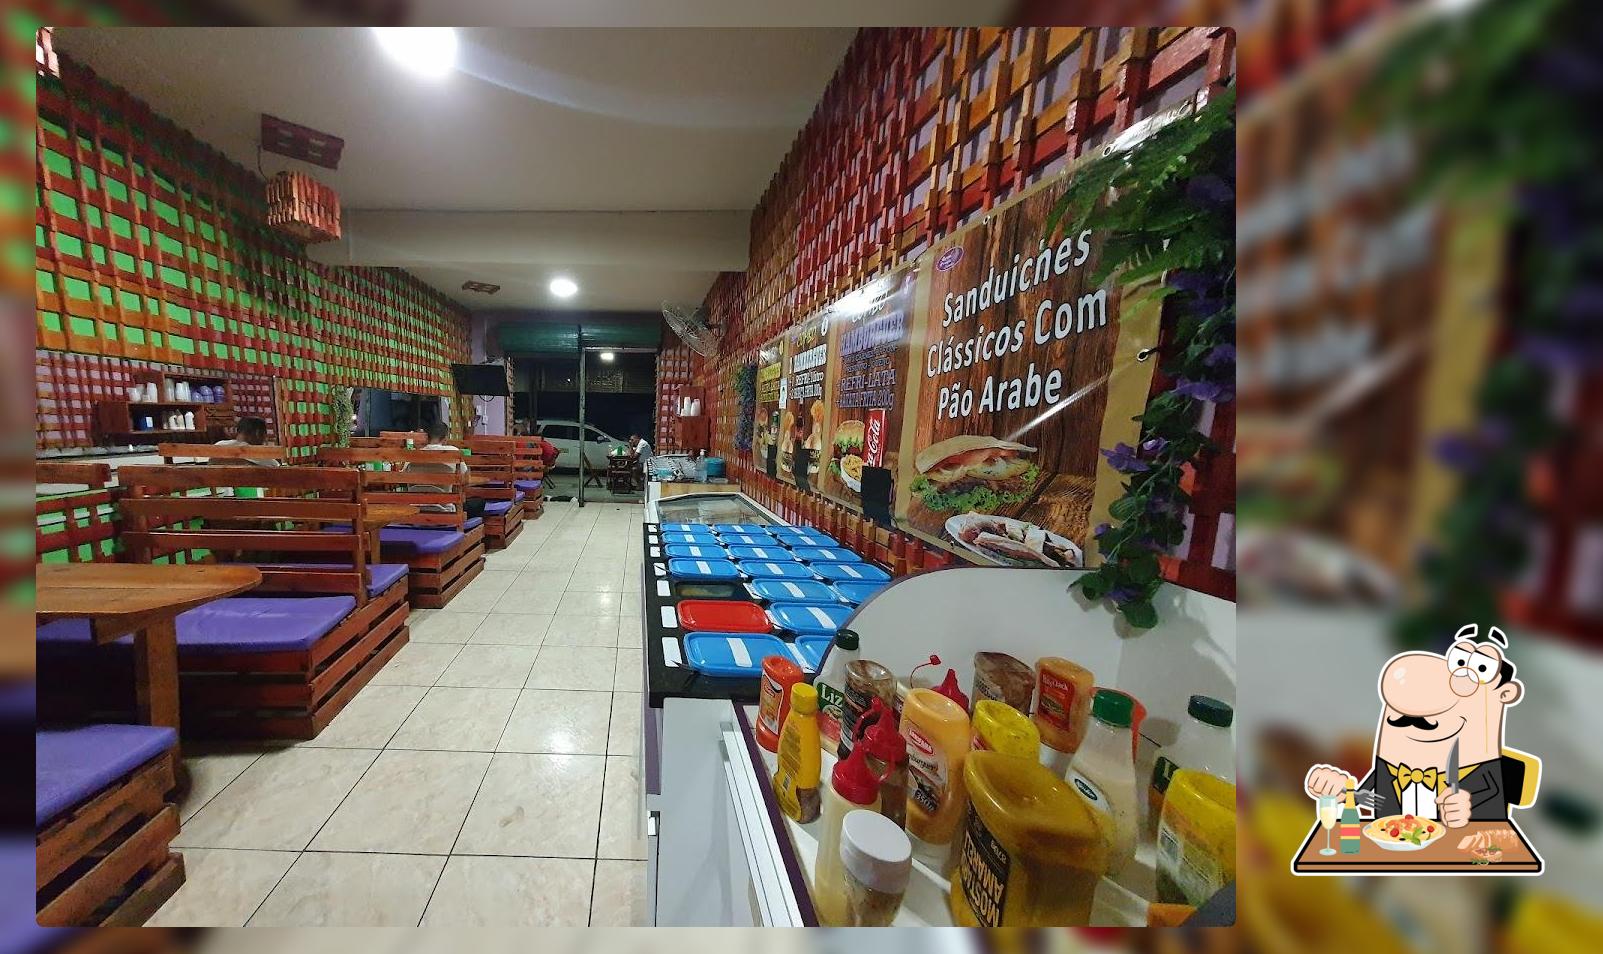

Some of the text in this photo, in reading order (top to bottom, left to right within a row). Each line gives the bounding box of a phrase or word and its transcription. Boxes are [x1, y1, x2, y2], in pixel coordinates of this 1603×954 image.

[942, 229, 1092, 327] Sanduiches
[927, 289, 1107, 378] Clássicos Com
[937, 363, 1062, 420] Pão Arabe
